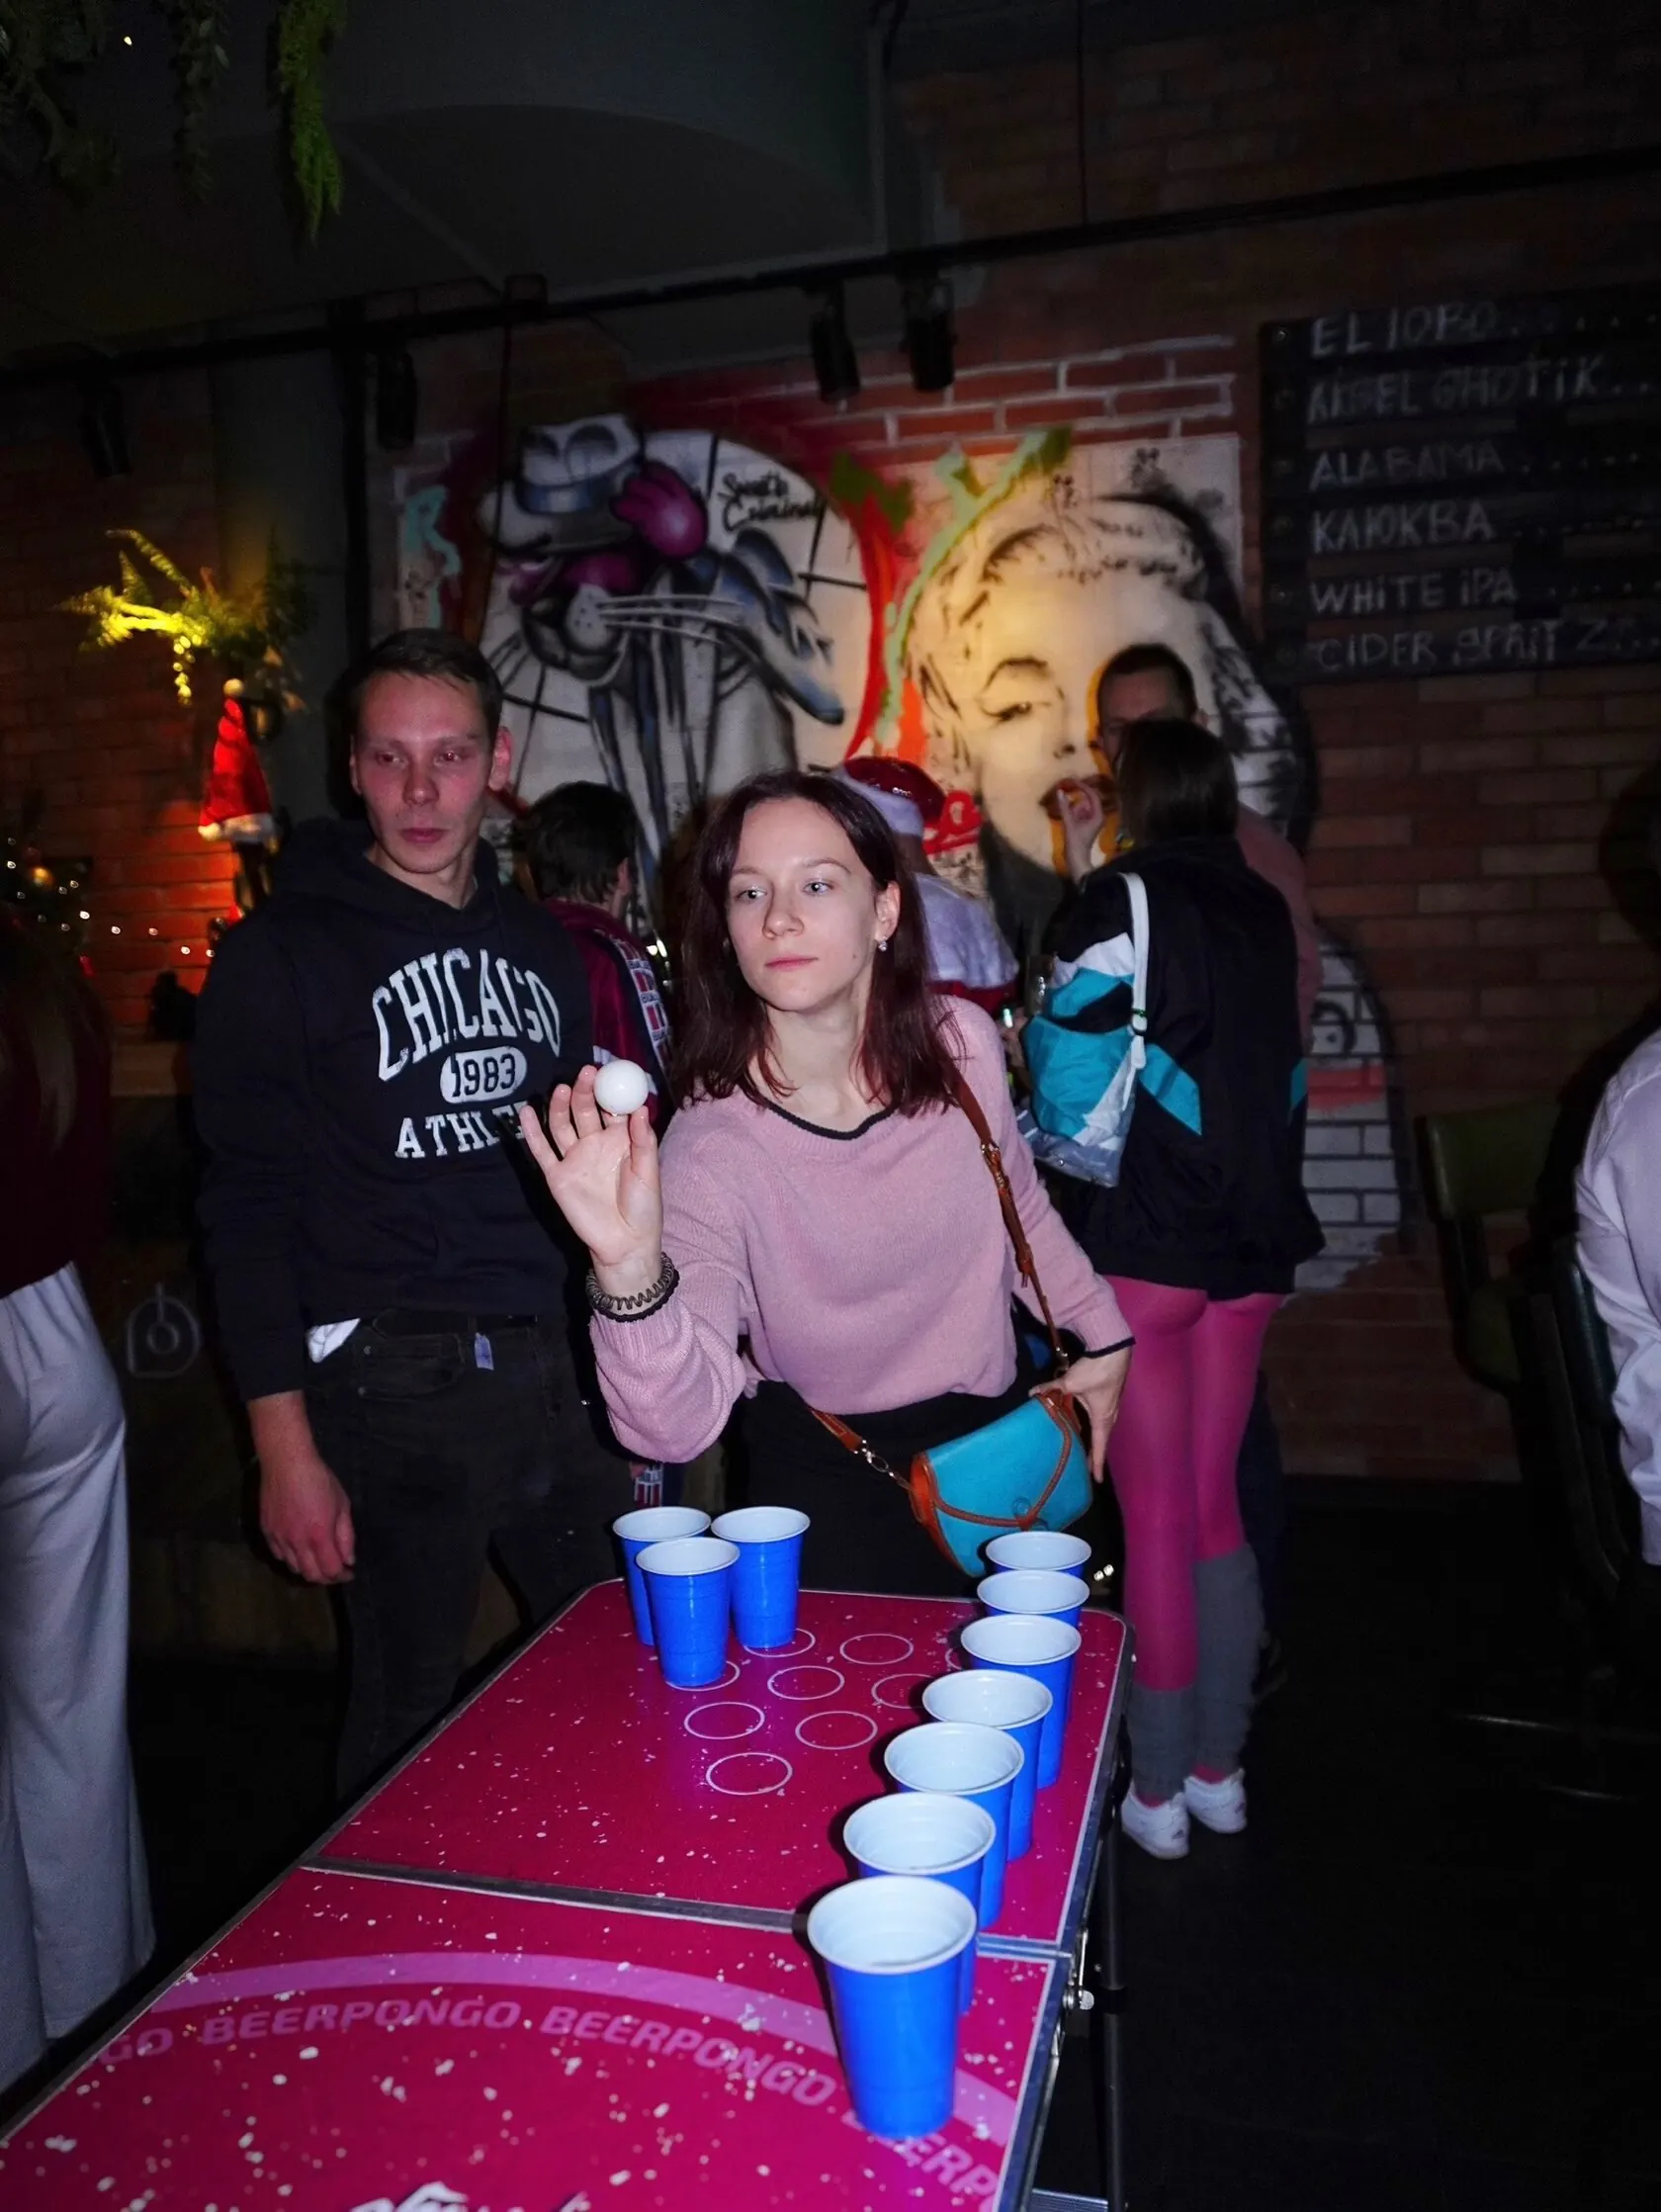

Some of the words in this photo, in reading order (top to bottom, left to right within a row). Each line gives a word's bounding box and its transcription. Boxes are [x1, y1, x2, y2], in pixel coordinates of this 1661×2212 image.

[1310, 312, 1373, 360] EL
[1309, 439, 1505, 491] ALABAMA
[1310, 629, 1438, 673] CIDER
[372, 946, 562, 1082] CHICAGO
[449, 1053, 517, 1098] 1983
[203, 1998, 521, 2046] BEERPONGO
[540, 2005, 838, 2107] BEERPONGO
